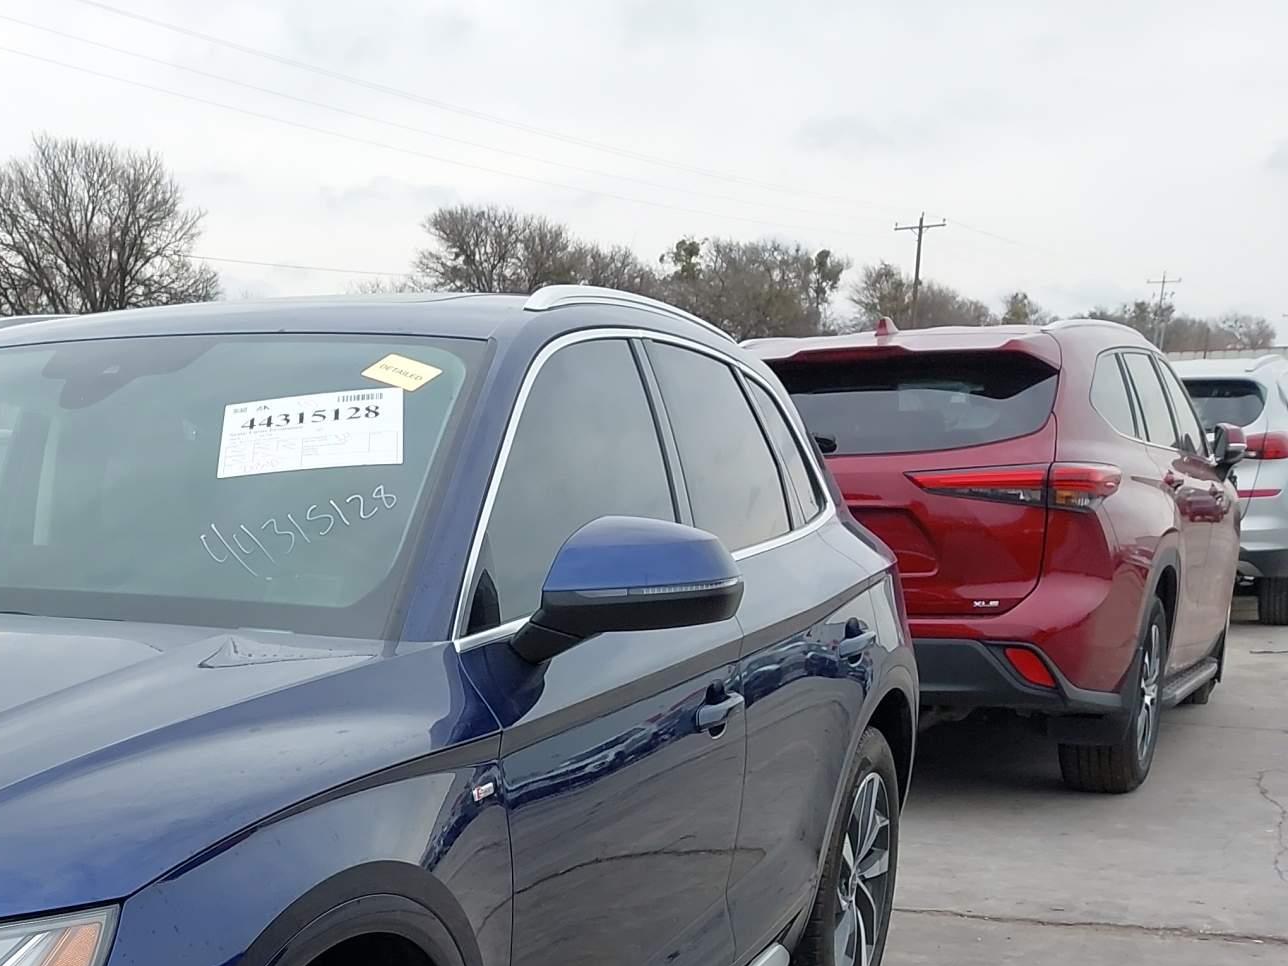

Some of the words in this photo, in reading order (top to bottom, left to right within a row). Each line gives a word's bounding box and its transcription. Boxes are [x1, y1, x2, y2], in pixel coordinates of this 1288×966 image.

[379, 363, 424, 381] DETAILED
[241, 404, 381, 430] 44315128
[200, 484, 397, 577] 44315128
